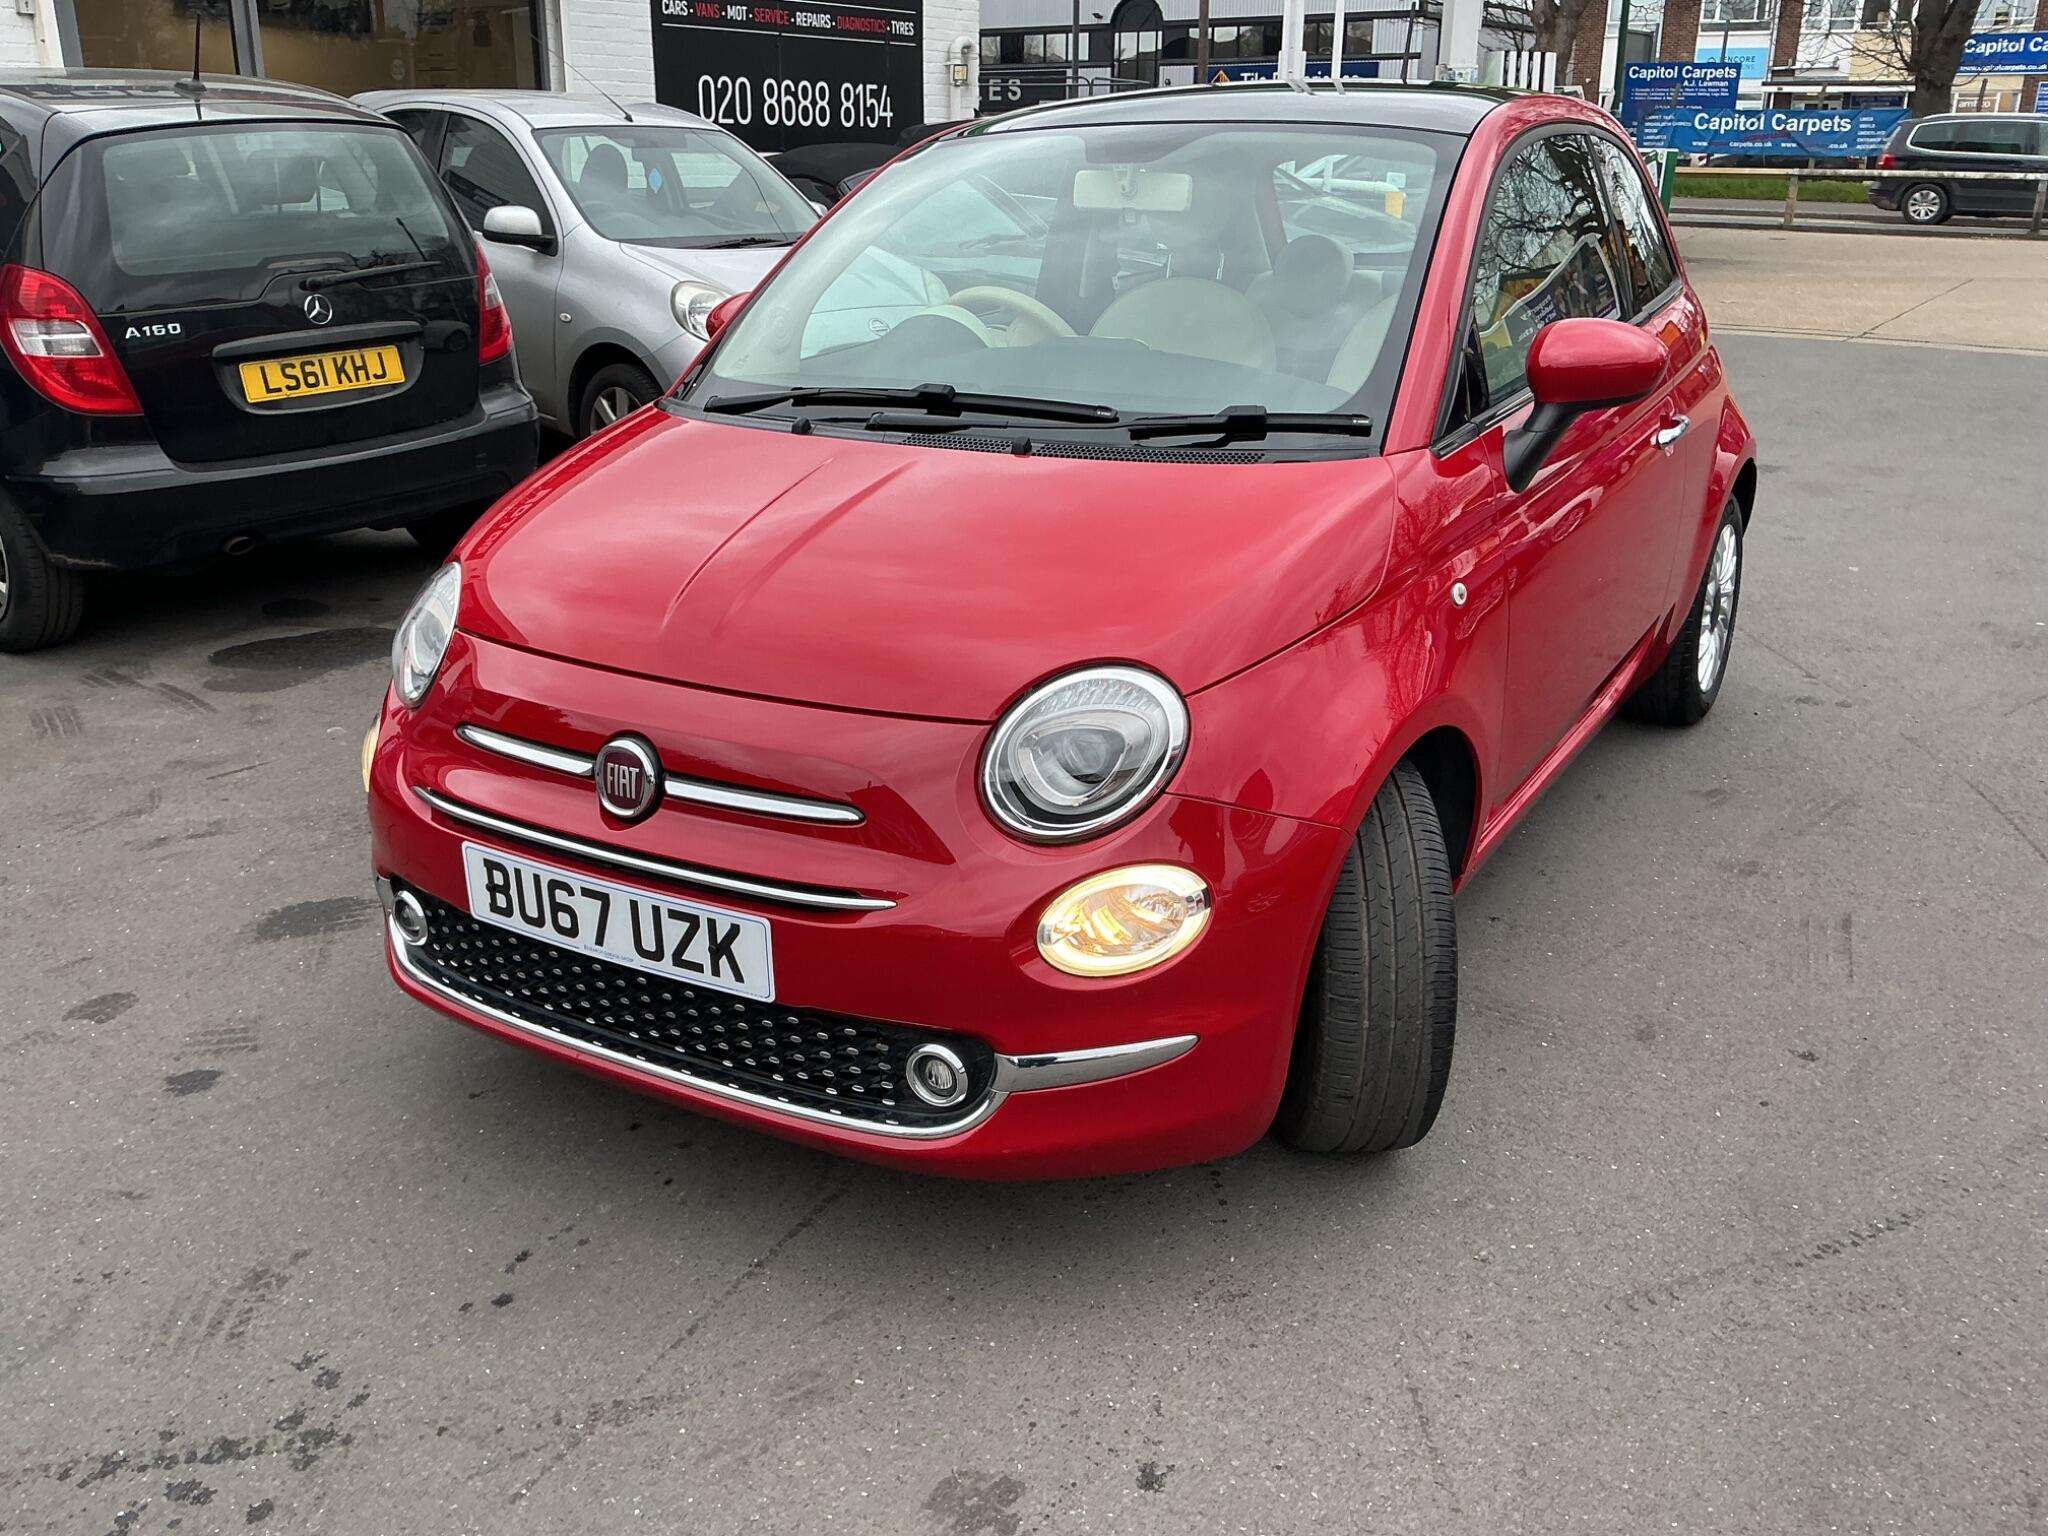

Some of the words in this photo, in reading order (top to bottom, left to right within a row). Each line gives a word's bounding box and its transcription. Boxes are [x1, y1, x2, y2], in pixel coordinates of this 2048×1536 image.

[662, 0, 688, 16] CARS
[695, 2, 720, 18] VANS
[727, 5, 748, 20] MOT
[754, 7, 789, 25] SERVICE
[796, 12, 831, 28] REPAIRS
[837, 15, 886, 33] DIAGNOSTICS
[891, 20, 915, 36] TYRES
[1964, 38, 2026, 56] Capitol
[978, 78, 1022, 101] ES
[1629, 66, 1679, 81] Capitol
[1682, 65, 1738, 80] Carpets
[698, 74, 752, 124] 020
[763, 78, 830, 127] 8688
[840, 82, 893, 128] 8154
[1694, 112, 1764, 134] Capitol
[1771, 113, 1852, 135] Carpets
[259, 360, 329, 395] LS61
[332, 352, 388, 385] KHJ
[607, 762, 640, 799] FIAT
[483, 858, 610, 948] BU67
[629, 899, 745, 984] UZK
